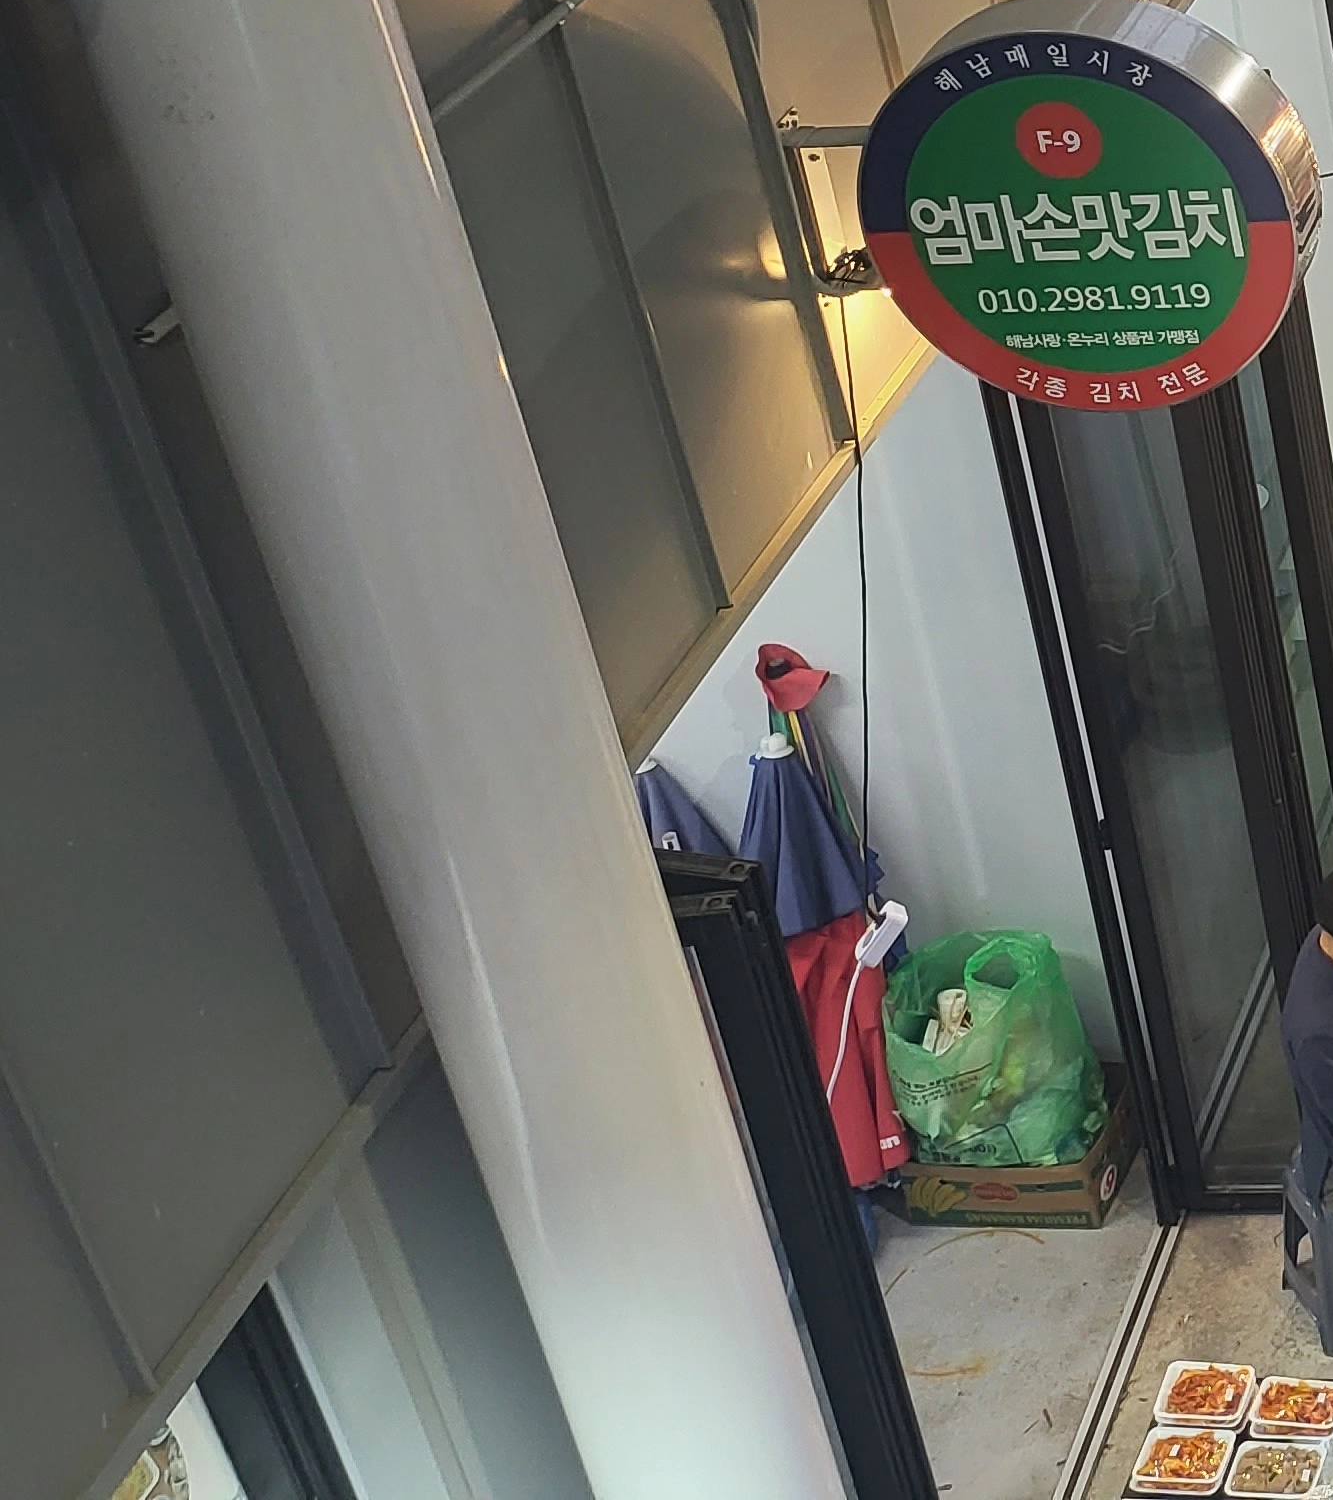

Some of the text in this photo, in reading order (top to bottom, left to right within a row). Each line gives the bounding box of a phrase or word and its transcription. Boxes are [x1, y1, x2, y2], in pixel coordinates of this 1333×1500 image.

[934, 43, 1154, 94] 해남매일시장
[1036, 130, 1081, 154] F-9
[910, 188, 1246, 266] 엄마손맛김치
[979, 283, 1211, 315] 010.2981.9119
[1112, 330, 1155, 347] 상품권
[1157, 329, 1200, 346] 가맹점
[1014, 362, 1210, 403] 각종 김치 전문
